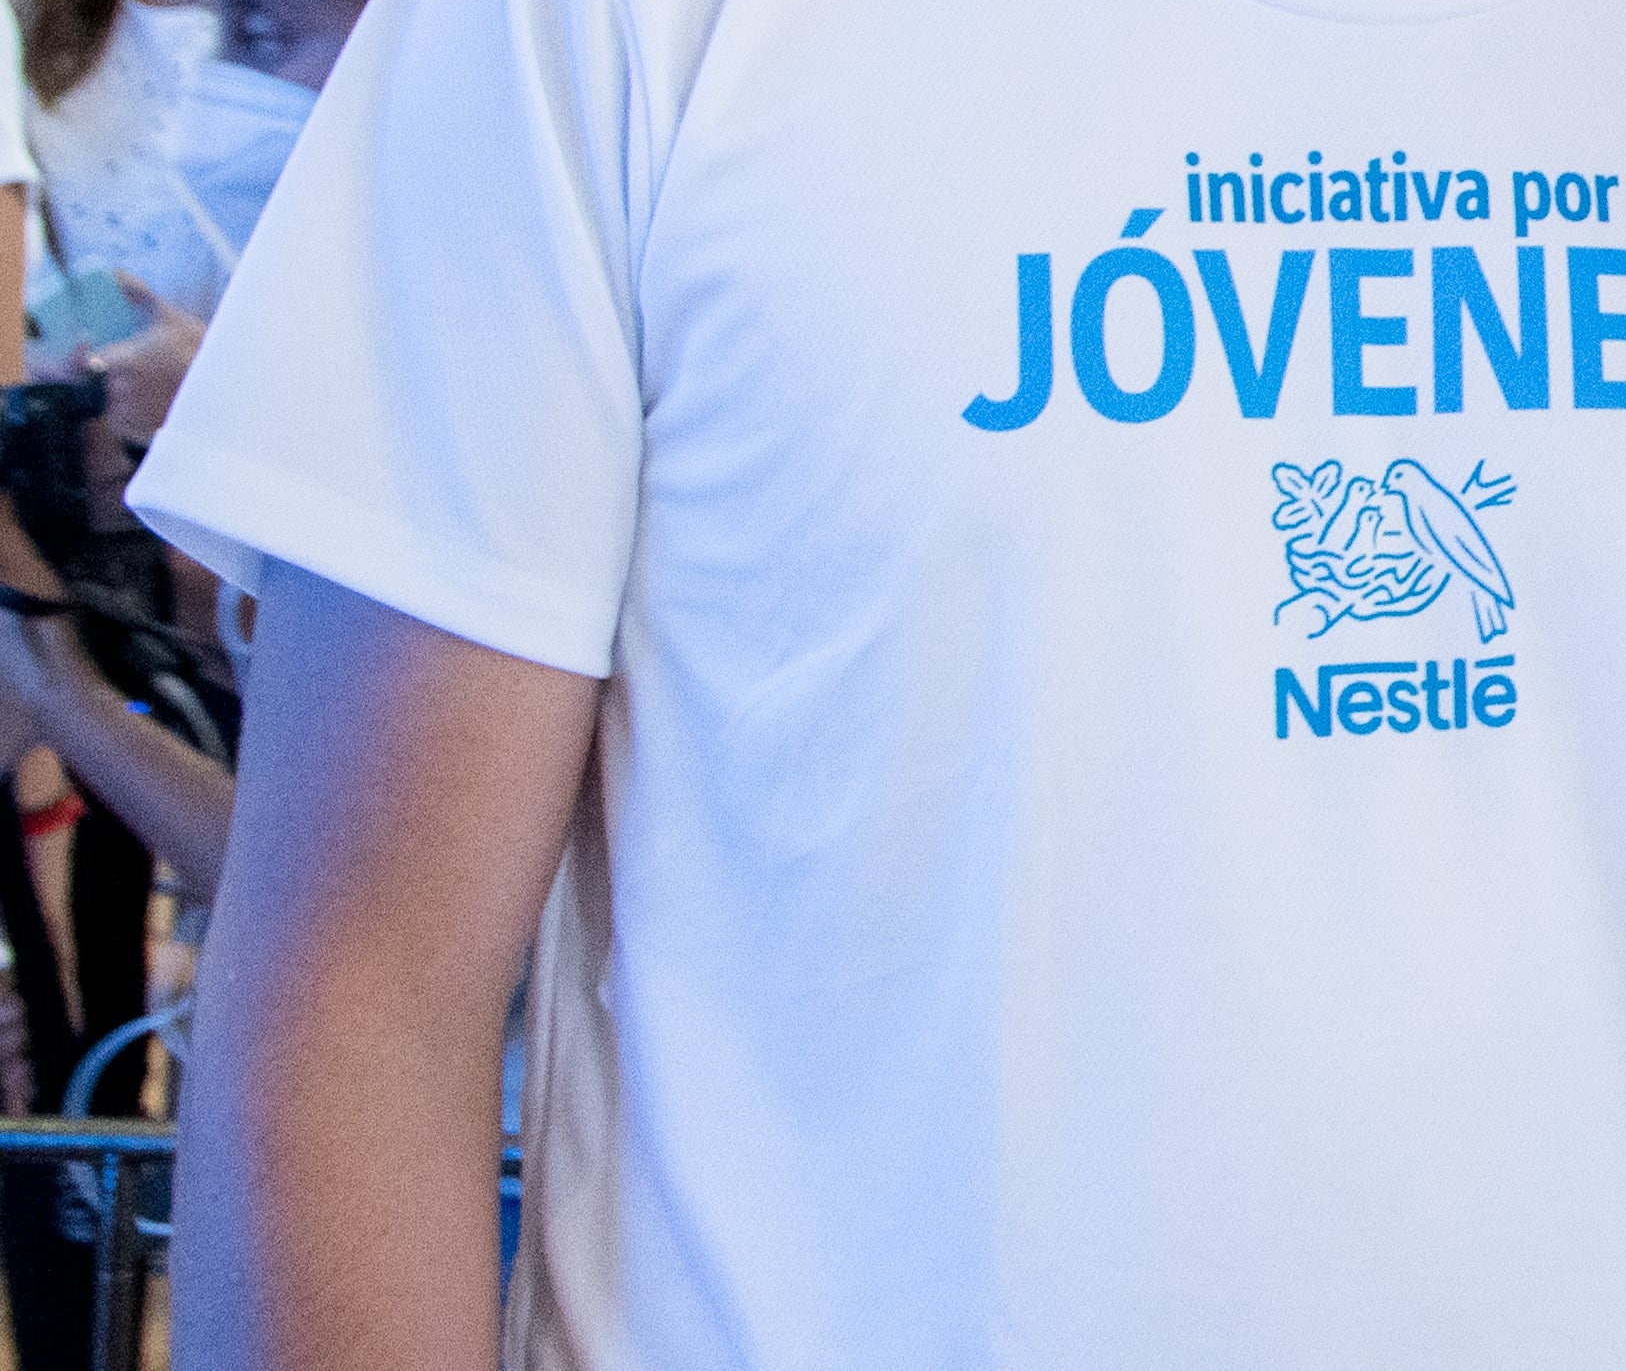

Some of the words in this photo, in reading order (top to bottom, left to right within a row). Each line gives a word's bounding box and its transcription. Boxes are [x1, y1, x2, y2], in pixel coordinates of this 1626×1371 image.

[1185, 150, 1490, 225] iniciativa
[1512, 170, 1619, 238] por
[1274, 654, 1517, 740] Nestlé
